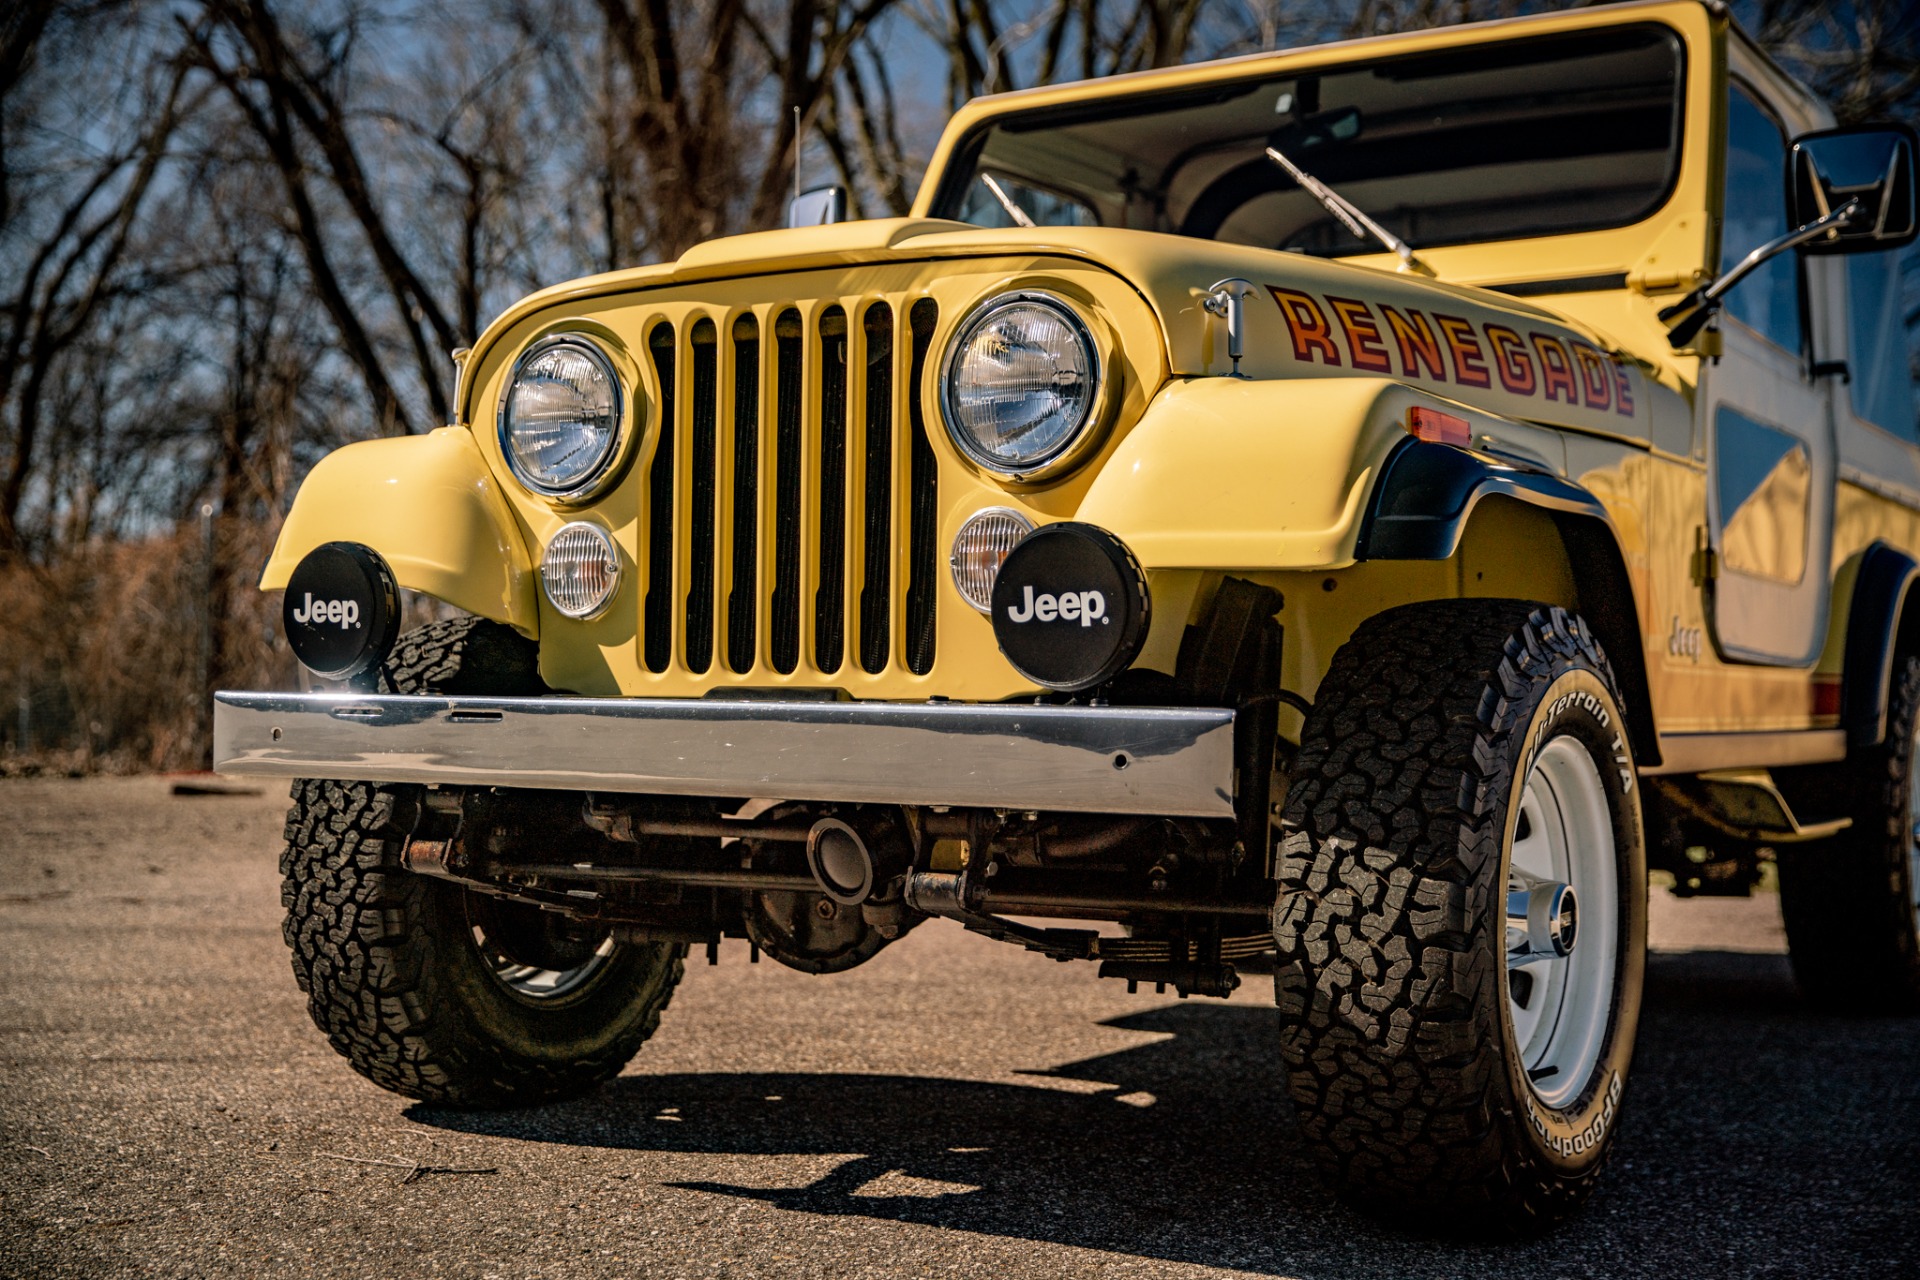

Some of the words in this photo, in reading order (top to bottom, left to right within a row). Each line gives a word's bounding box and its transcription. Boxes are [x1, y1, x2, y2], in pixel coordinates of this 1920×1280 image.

[1264, 284, 1634, 418] RENEGADE
[293, 592, 359, 630] Jeep
[1008, 585, 1106, 627] Jeep
